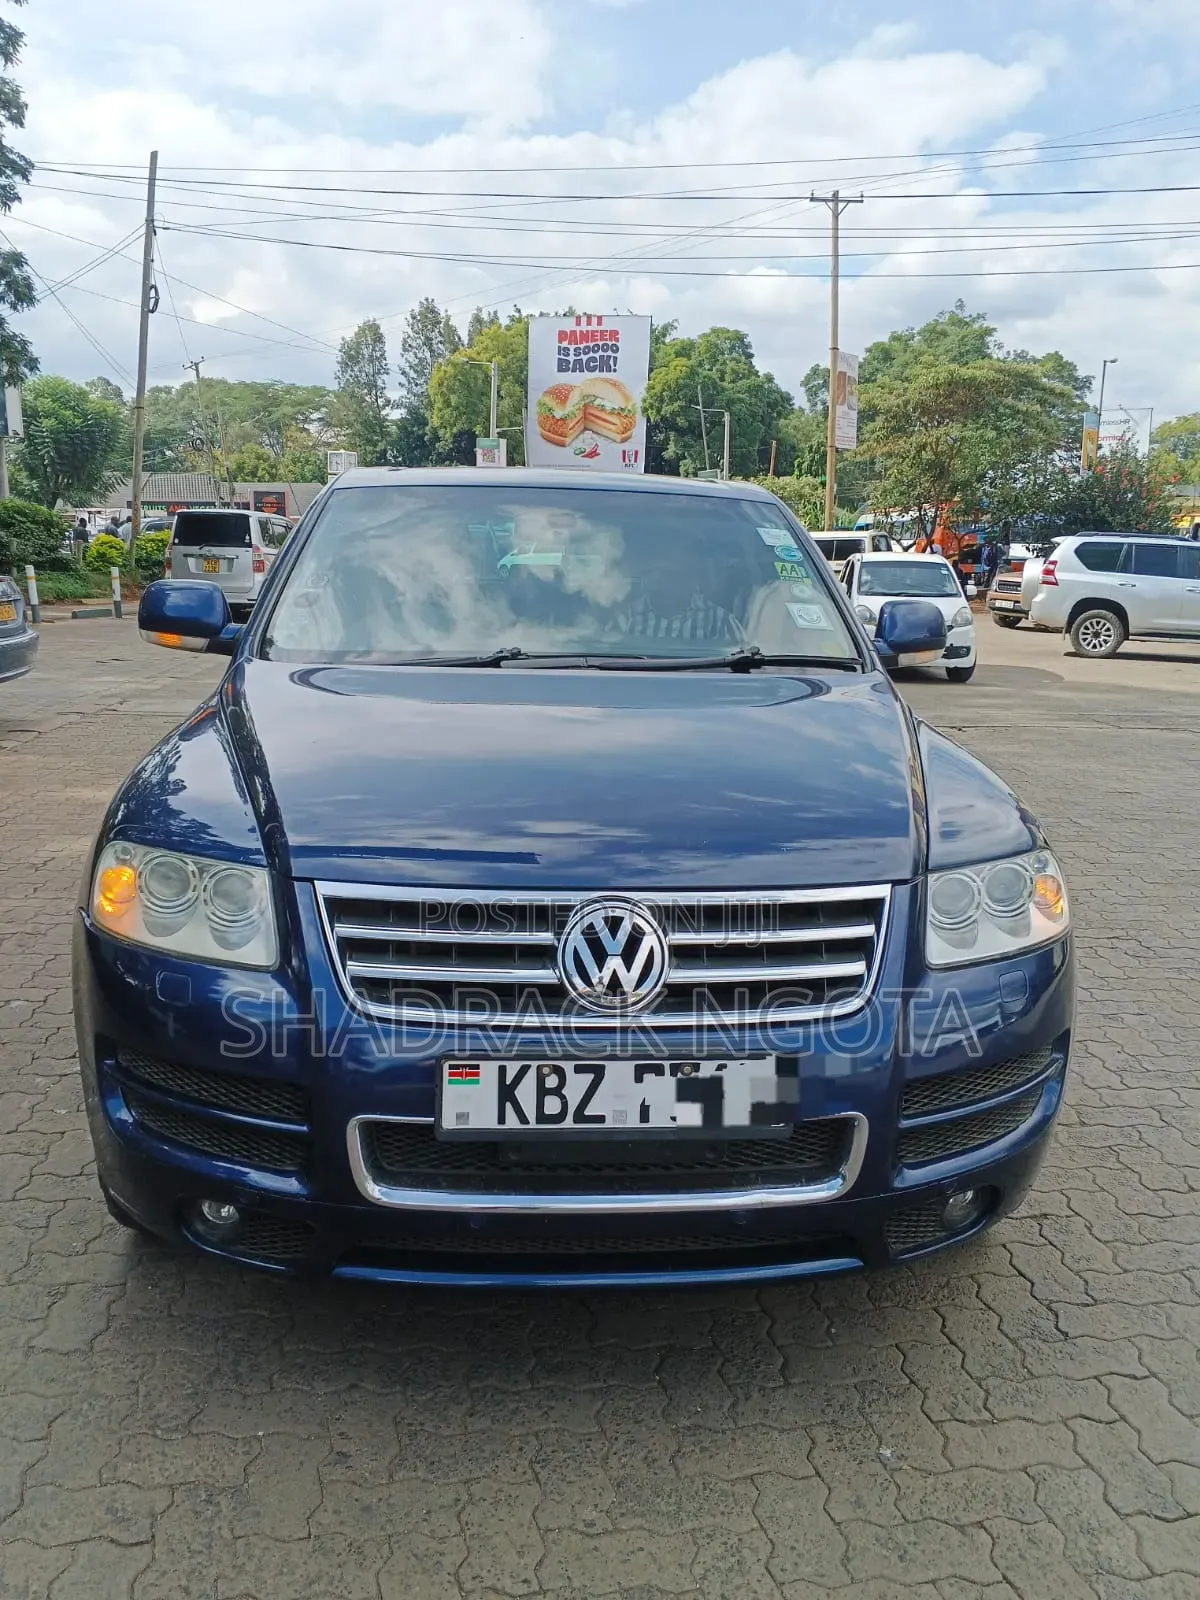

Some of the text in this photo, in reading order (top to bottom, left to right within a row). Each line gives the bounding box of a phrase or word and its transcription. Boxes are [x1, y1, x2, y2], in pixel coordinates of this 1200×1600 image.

[558, 330, 620, 346] PANEER
[557, 342, 620, 358] IS SOOOO
[557, 355, 618, 373] BACK!
[168, 503, 189, 513] AND
[780, 563, 799, 576] AA
[497, 1063, 607, 1125] KBZ
